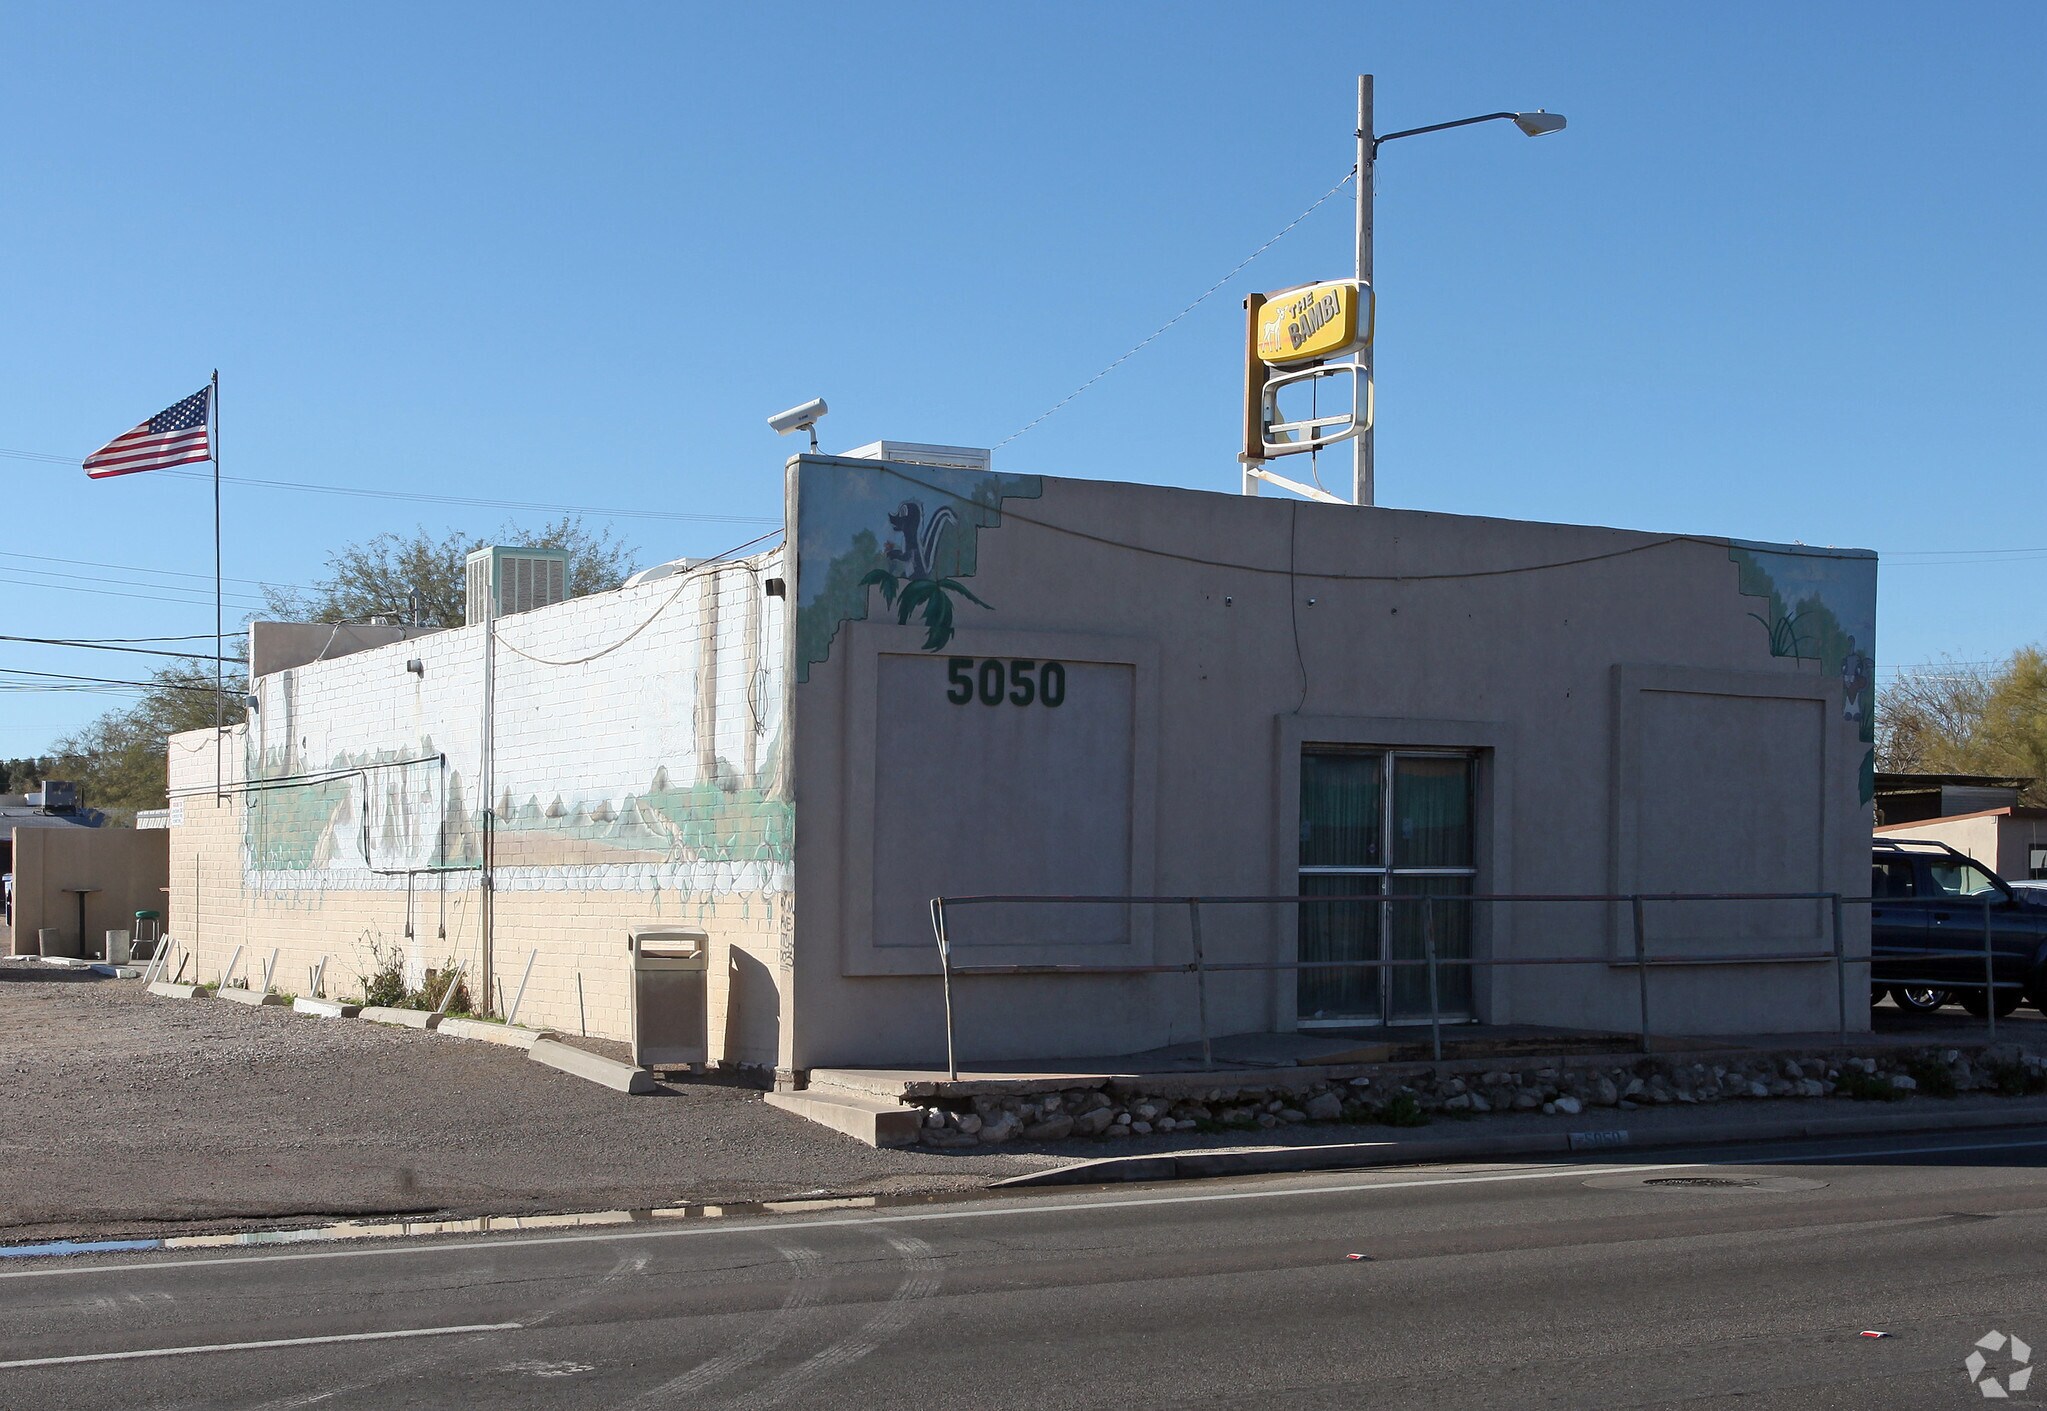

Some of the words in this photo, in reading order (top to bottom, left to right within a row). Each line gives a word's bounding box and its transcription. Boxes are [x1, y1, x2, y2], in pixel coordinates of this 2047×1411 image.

[1288, 289, 1341, 351] BAMBI
[1289, 291, 1315, 319] THE
[947, 657, 1066, 708] 5050
